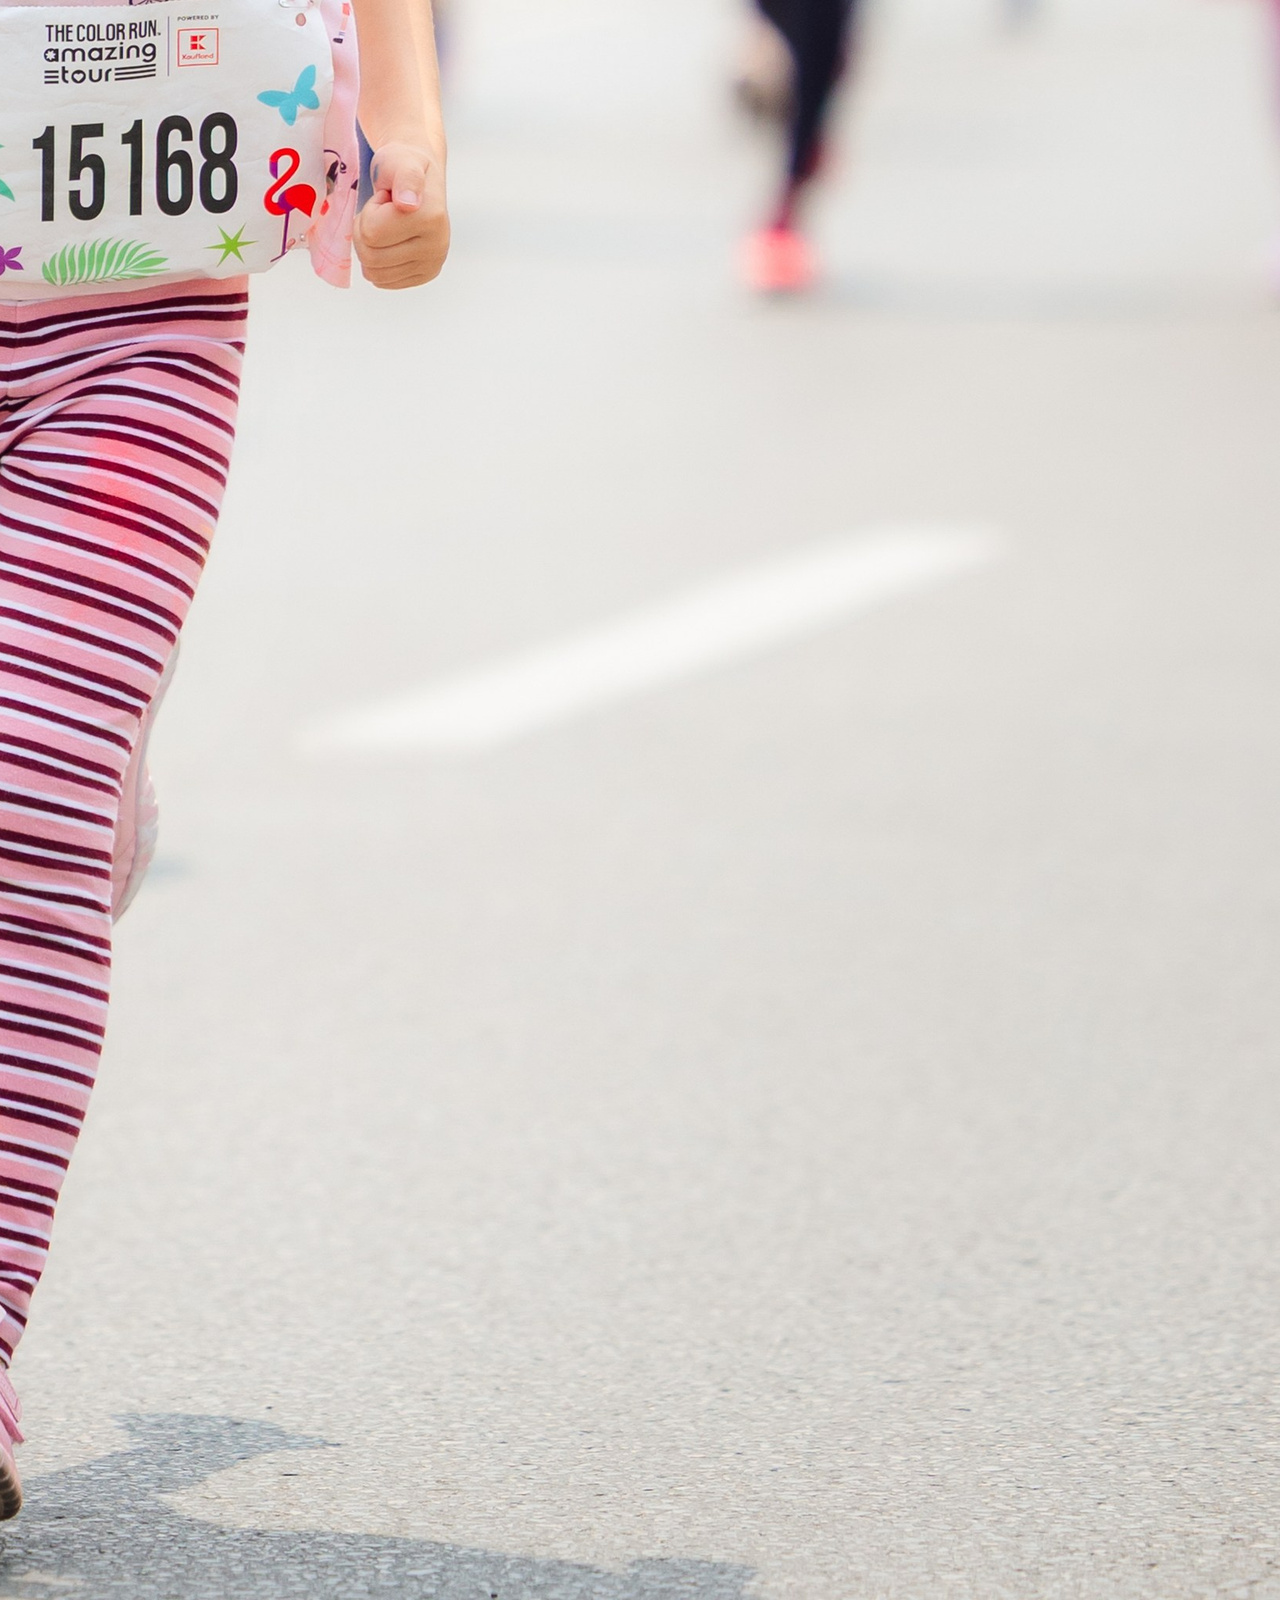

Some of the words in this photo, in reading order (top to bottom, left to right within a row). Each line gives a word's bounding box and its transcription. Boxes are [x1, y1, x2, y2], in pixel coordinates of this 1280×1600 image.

[45, 24, 74, 43] THE
[76, 23, 126, 42] COLOR
[43, 42, 157, 63] amazing
[61, 66, 113, 84] tour
[32, 112, 238, 222] 15168
